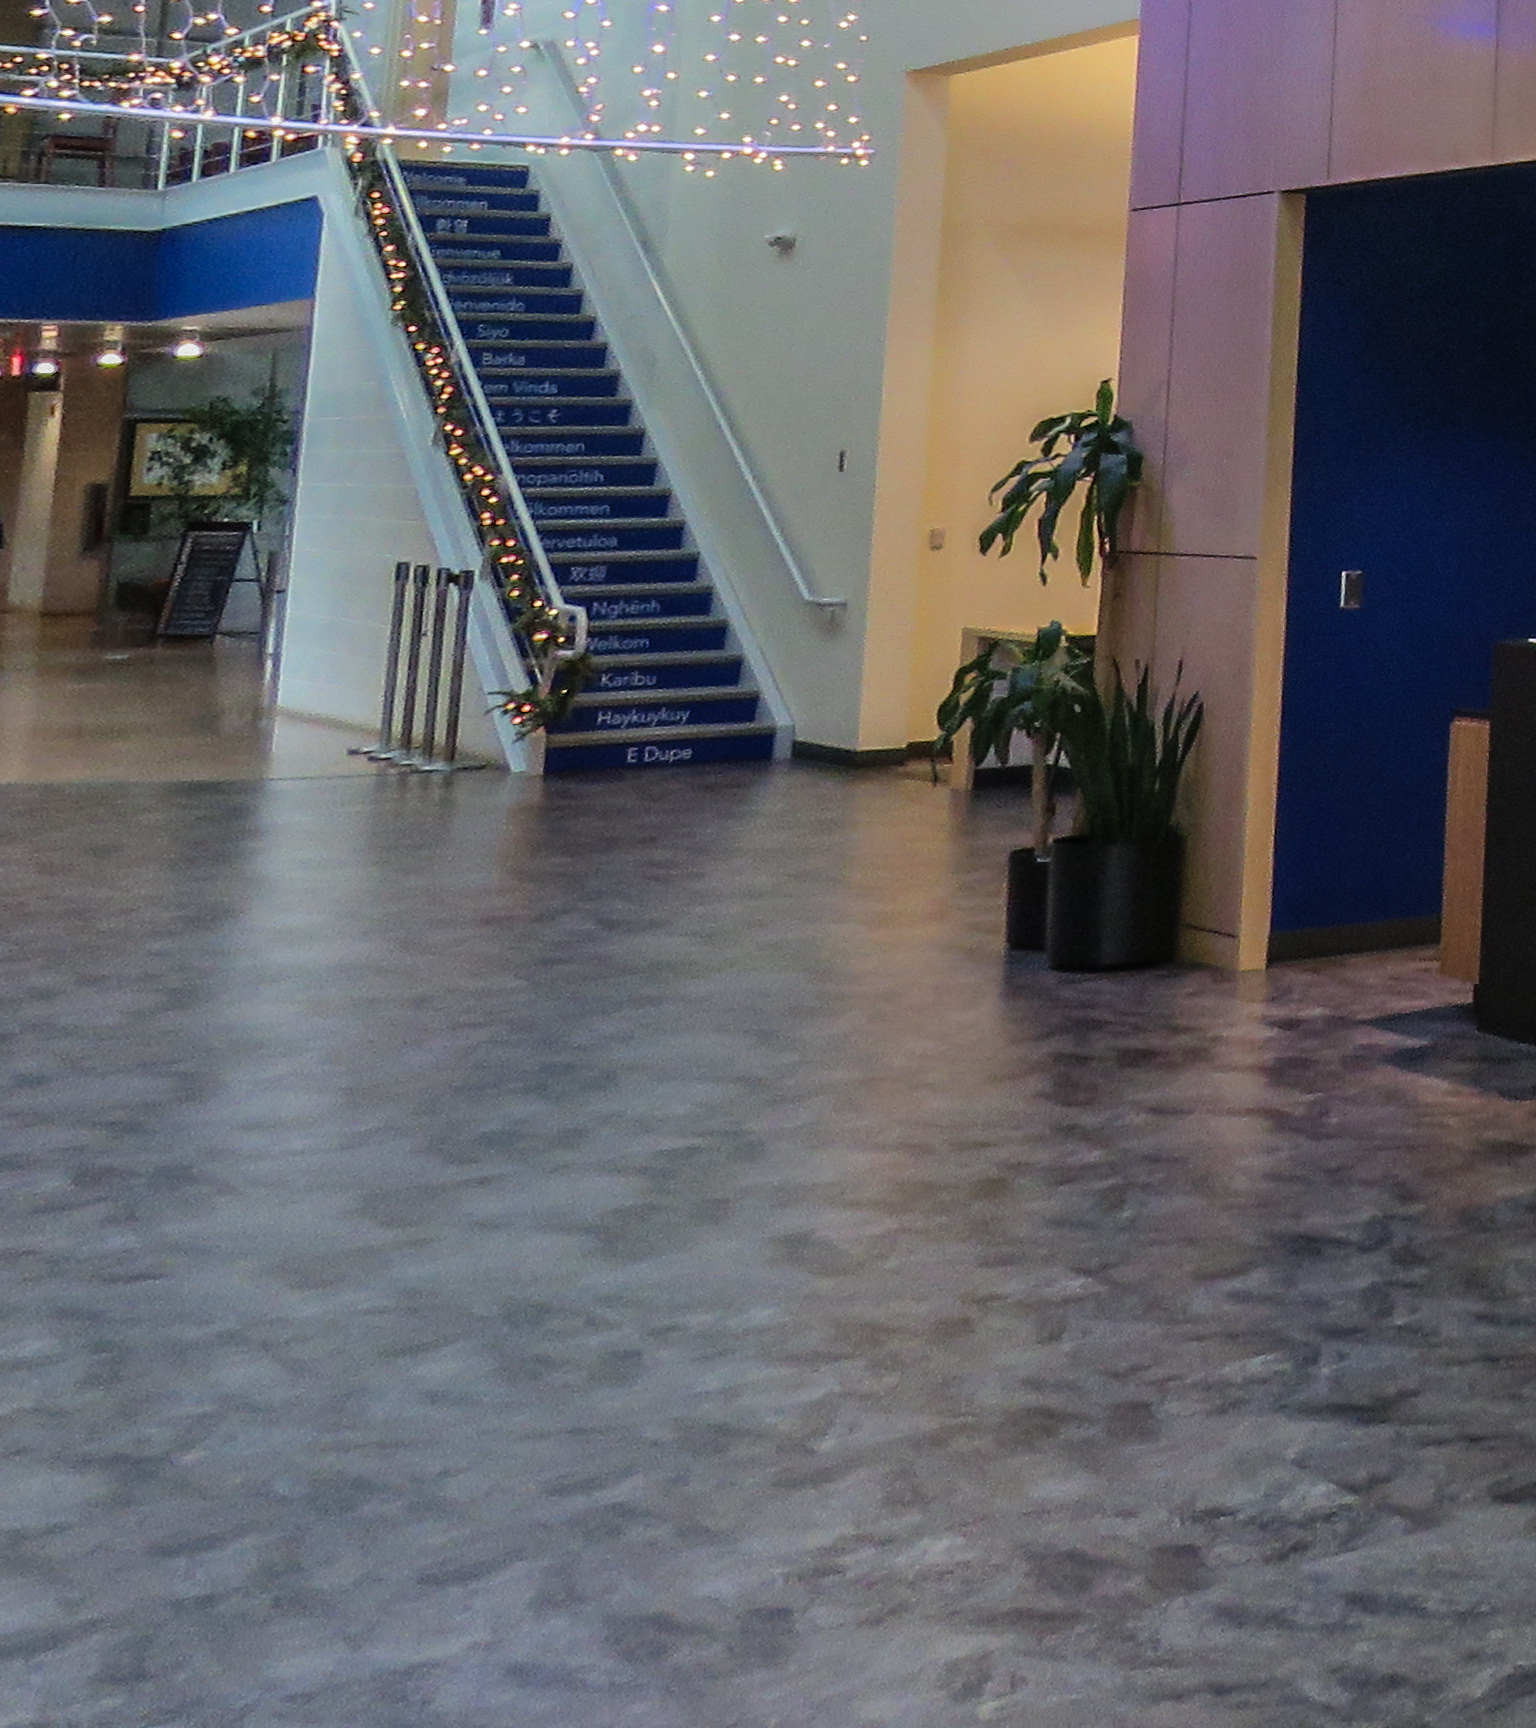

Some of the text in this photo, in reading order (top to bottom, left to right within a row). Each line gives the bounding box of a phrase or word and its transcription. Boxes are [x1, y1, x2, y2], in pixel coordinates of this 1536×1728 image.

[477, 323, 509, 338] Siyo
[481, 351, 526, 366] Barka
[483, 384, 508, 394] em
[539, 532, 618, 549] ervetuloa
[600, 670, 657, 687] Karibu
[596, 706, 691, 728] Haykuykuy
[626, 745, 693, 763] E Dupe
